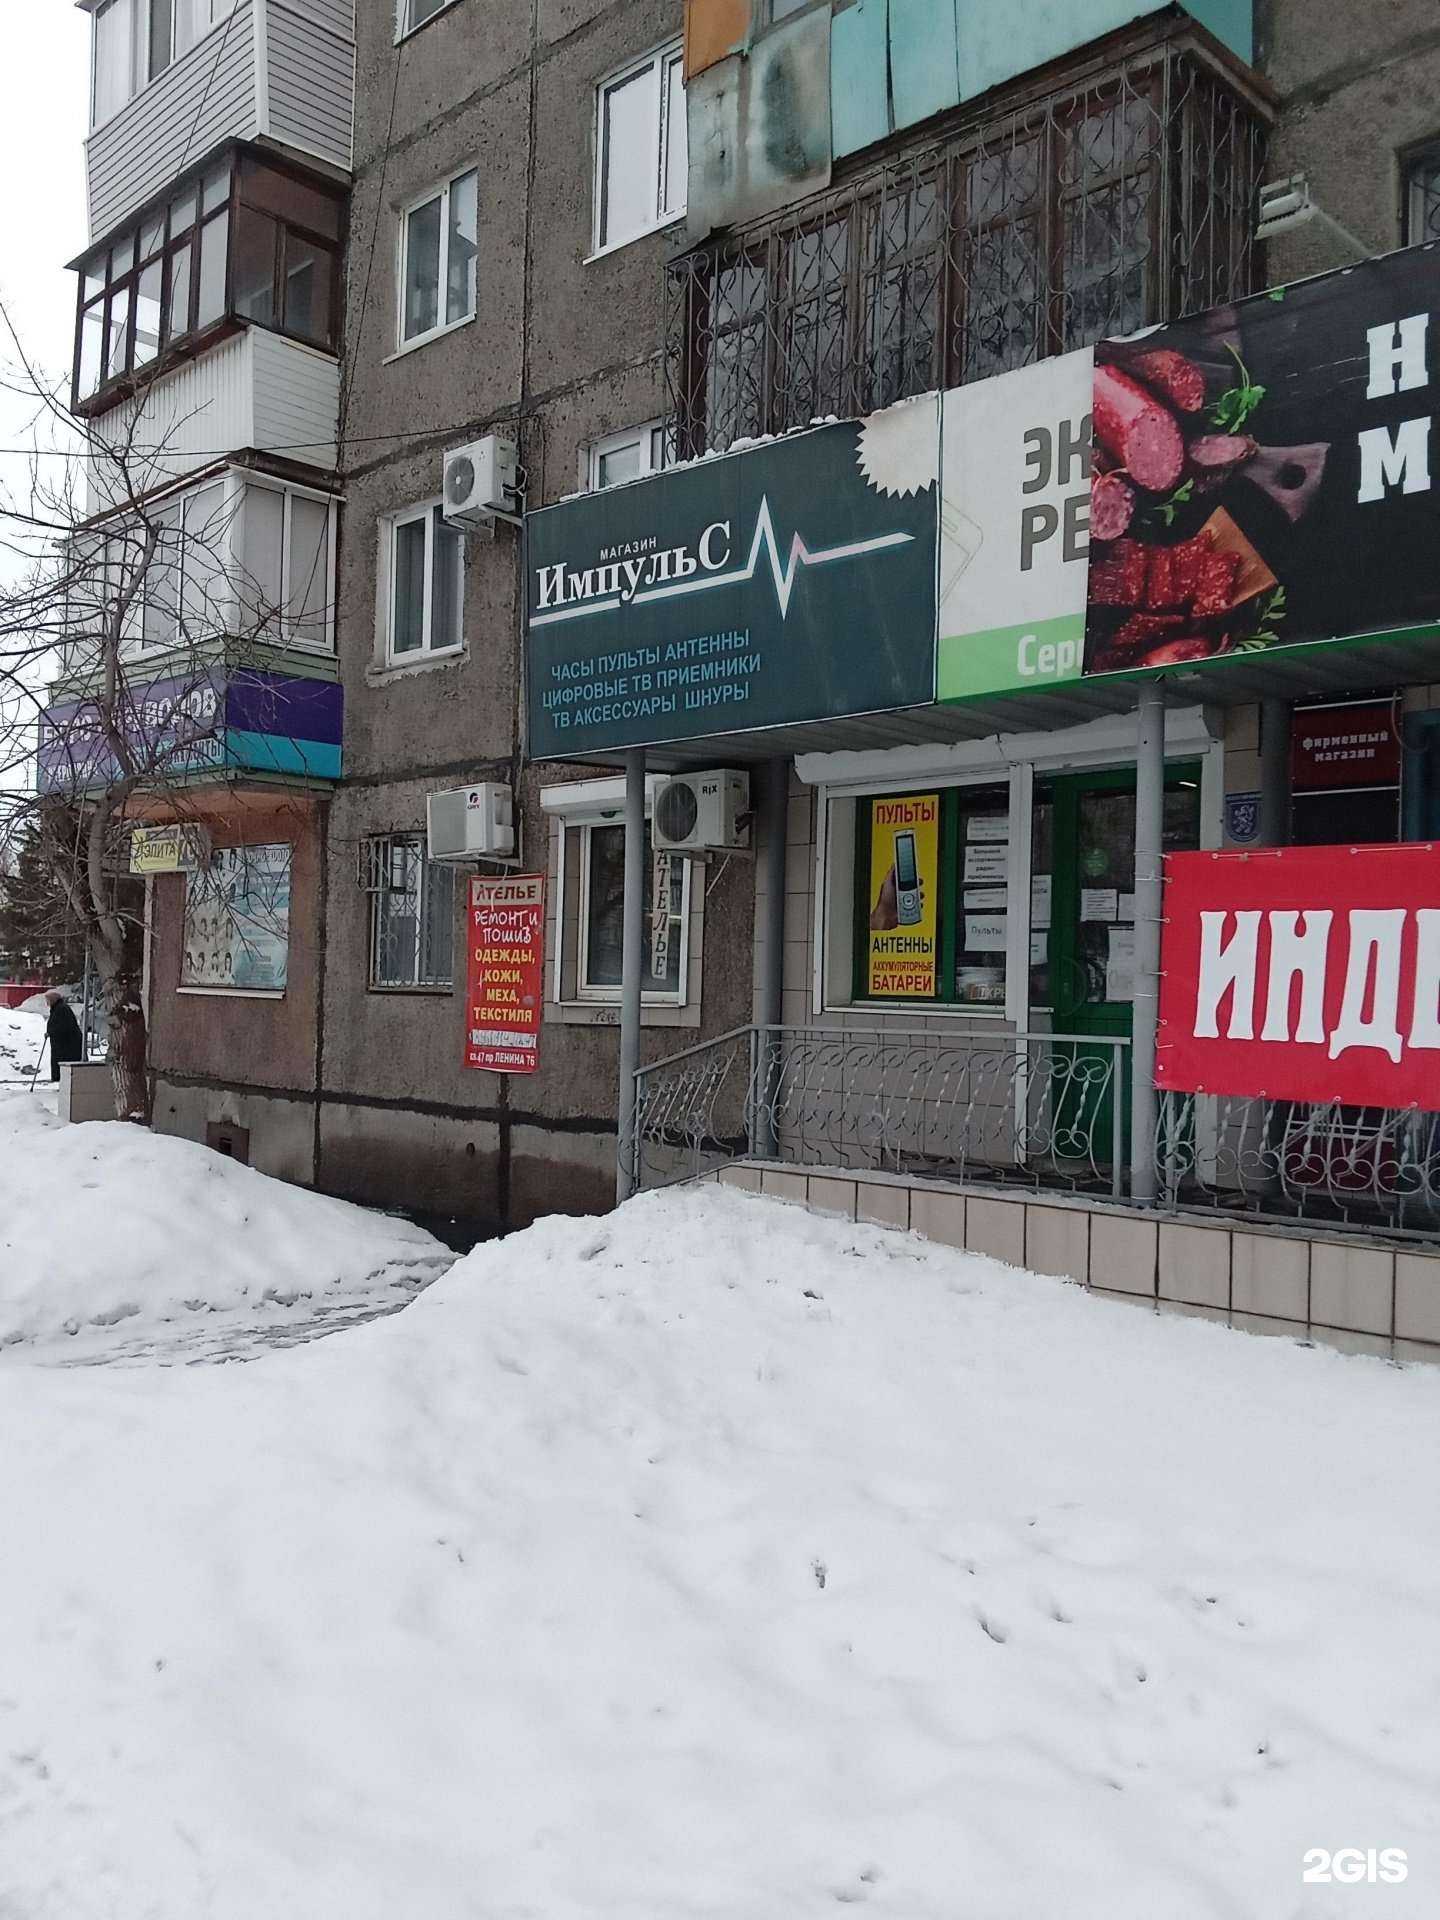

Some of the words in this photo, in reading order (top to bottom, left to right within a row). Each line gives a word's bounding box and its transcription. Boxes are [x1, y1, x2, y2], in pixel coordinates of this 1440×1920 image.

[1366, 313, 1429, 400] Н
[1358, 416, 1431, 504] М
[600, 536, 657, 560] МАГАЗИН
[536, 521, 730, 609] ИмпульС
[552, 659, 594, 681] ЧАСЫ
[598, 646, 660, 674] ПУЛЬТЫ
[665, 628, 749, 661] АНТЕННЫ
[542, 677, 627, 709] ЦИФРОВЫЕ
[632, 673, 652, 693] ТВ
[657, 653, 761, 688] ПРИЕМНИКИ
[552, 711, 570, 728] ТВ
[574, 694, 676, 726] АКСЕССУАРЫ
[685, 682, 749, 709] ШНУРЫ
[1302, 731, 1389, 750] Фирменный
[1314, 749, 1375, 762] магазин
[876, 801, 936, 825] ПУЛЬТЫ
[477, 885, 537, 901] АТЕЛЬЕ
[474, 910, 529, 927] РЕМОНТ
[653, 849, 670, 976] АТЕЛЬЕ
[483, 926, 532, 944] ПОШИВ
[873, 936, 933, 954] АНТЕННЫ
[475, 949, 536, 965] ОДЕЖДЫ,
[484, 970, 523, 985] КОЖИ,
[873, 974, 932, 991] БАТАРЕИ
[486, 989, 519, 1005] МЕХА,
[473, 1007, 532, 1023] ТЕКСТИЛЯ
[494, 1052, 525, 1065] ЛЕНИНА
